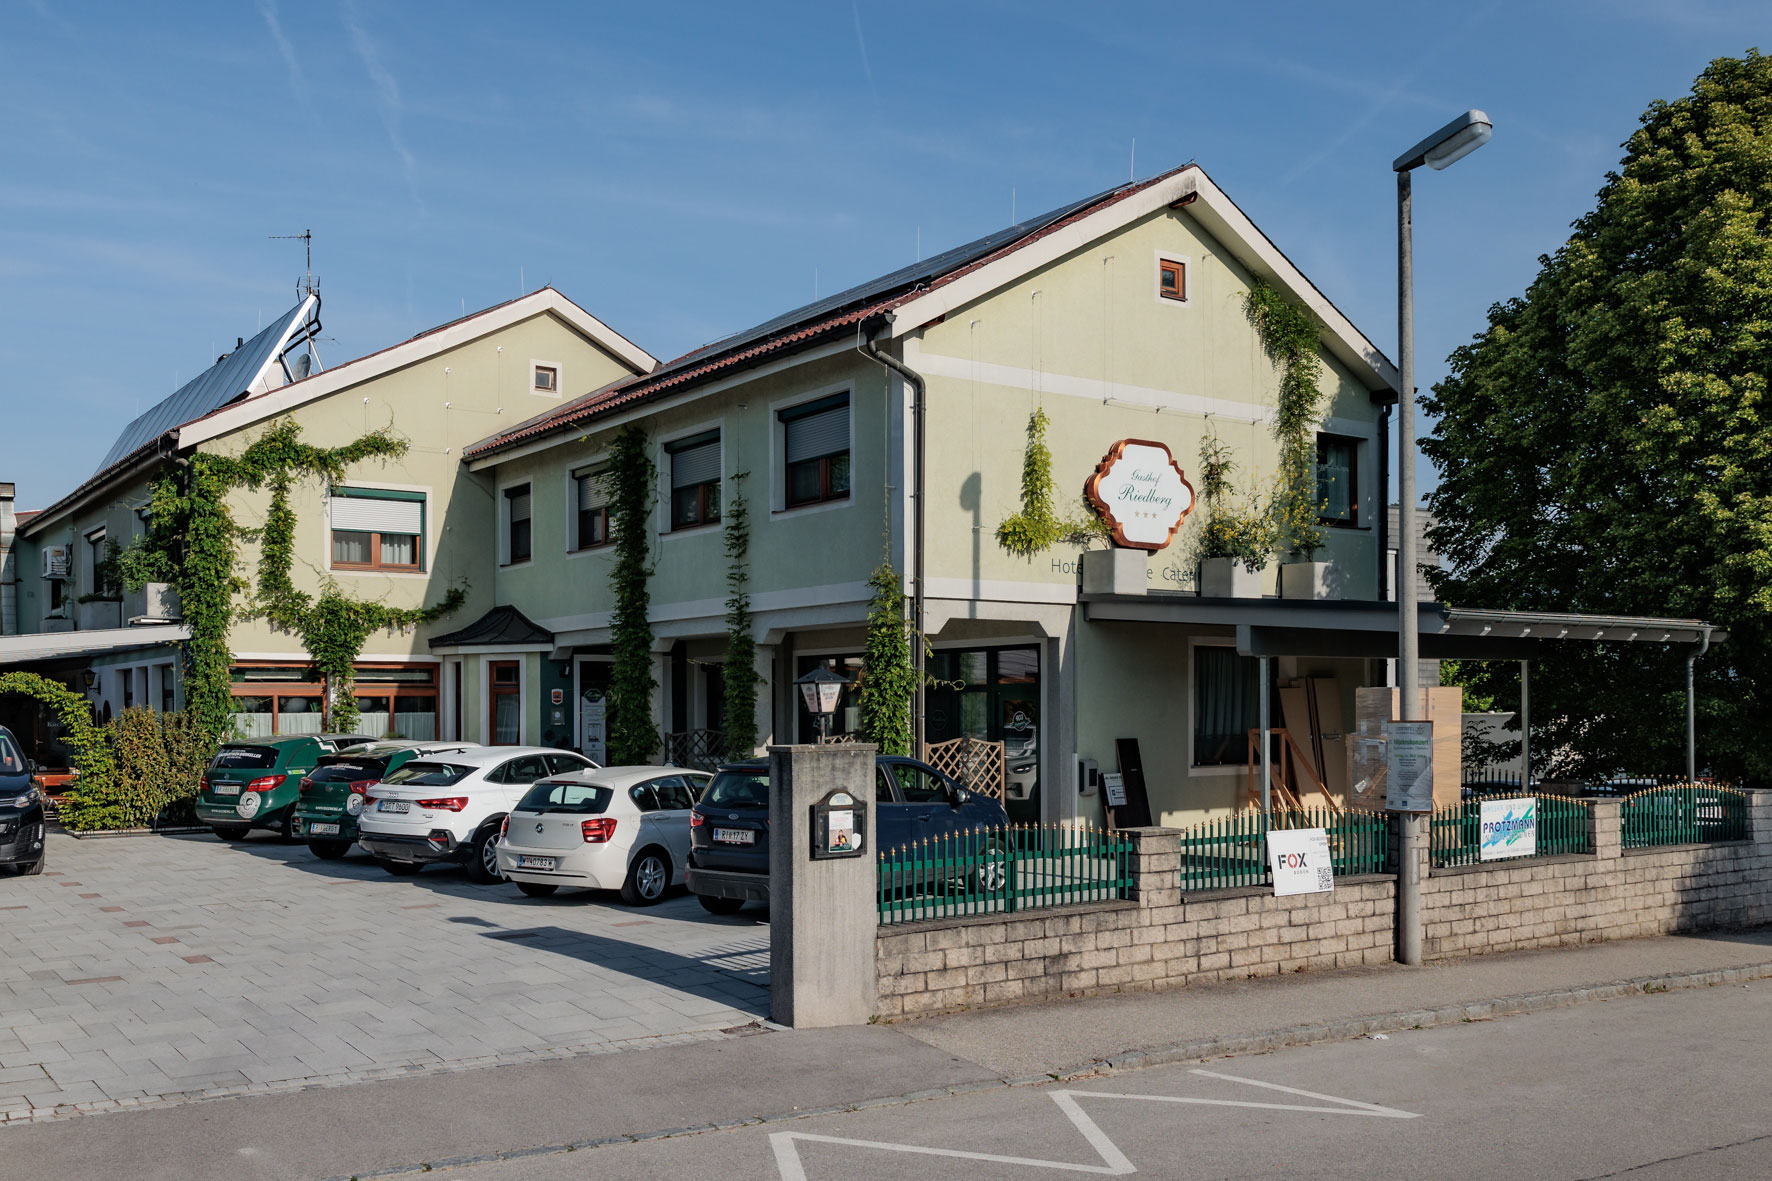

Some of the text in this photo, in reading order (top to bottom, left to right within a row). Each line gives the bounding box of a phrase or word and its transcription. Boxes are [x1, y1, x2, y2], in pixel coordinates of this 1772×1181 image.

[1131, 468, 1162, 487] Gasthof
[1117, 484, 1173, 511] Riedberg
[1051, 558, 1084, 575] Hote
[1483, 818, 1535, 834] PROTZMANN
[1277, 852, 1308, 870] FOX
